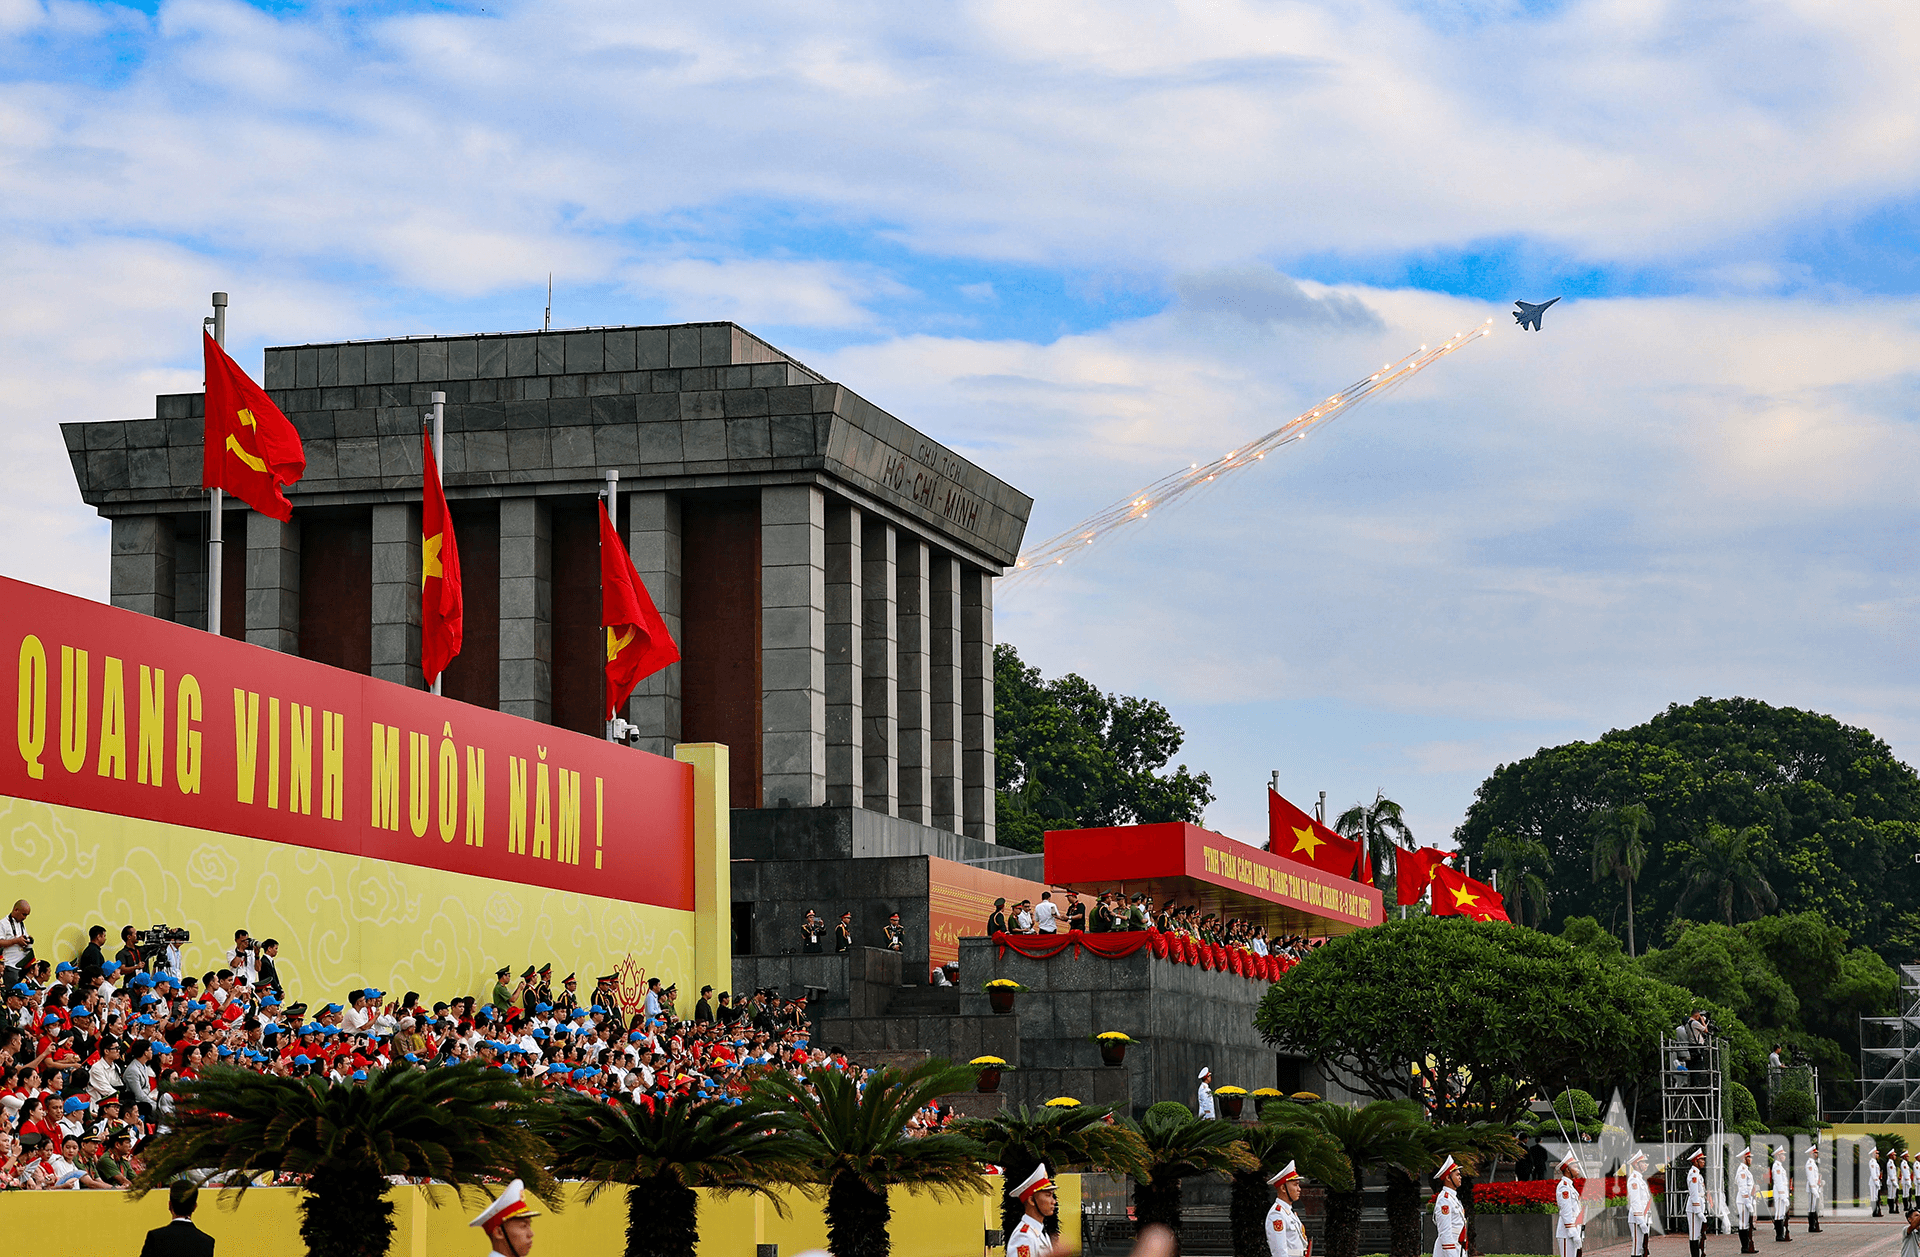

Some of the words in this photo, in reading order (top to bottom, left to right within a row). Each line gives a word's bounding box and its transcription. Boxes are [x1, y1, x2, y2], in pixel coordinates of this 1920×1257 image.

[942, 454, 962, 482] TỊCH
[17, 634, 203, 795] QUANG
[234, 687, 344, 822] VINH
[370, 720, 486, 849] MUÔN
[1203, 845, 1219, 875] TINH
[1220, 845, 1237, 881] THẦN
[1237, 853, 1253, 886] CÁCH
[1253, 862, 1270, 894] MẠNG
[1269, 866, 1289, 897] THÁNG
[1288, 871, 1301, 901] TÁM
[1301, 874, 1309, 904] VÀ
[1309, 876, 1322, 907] QUỐC
[1322, 883, 1339, 912] KHÁNH
